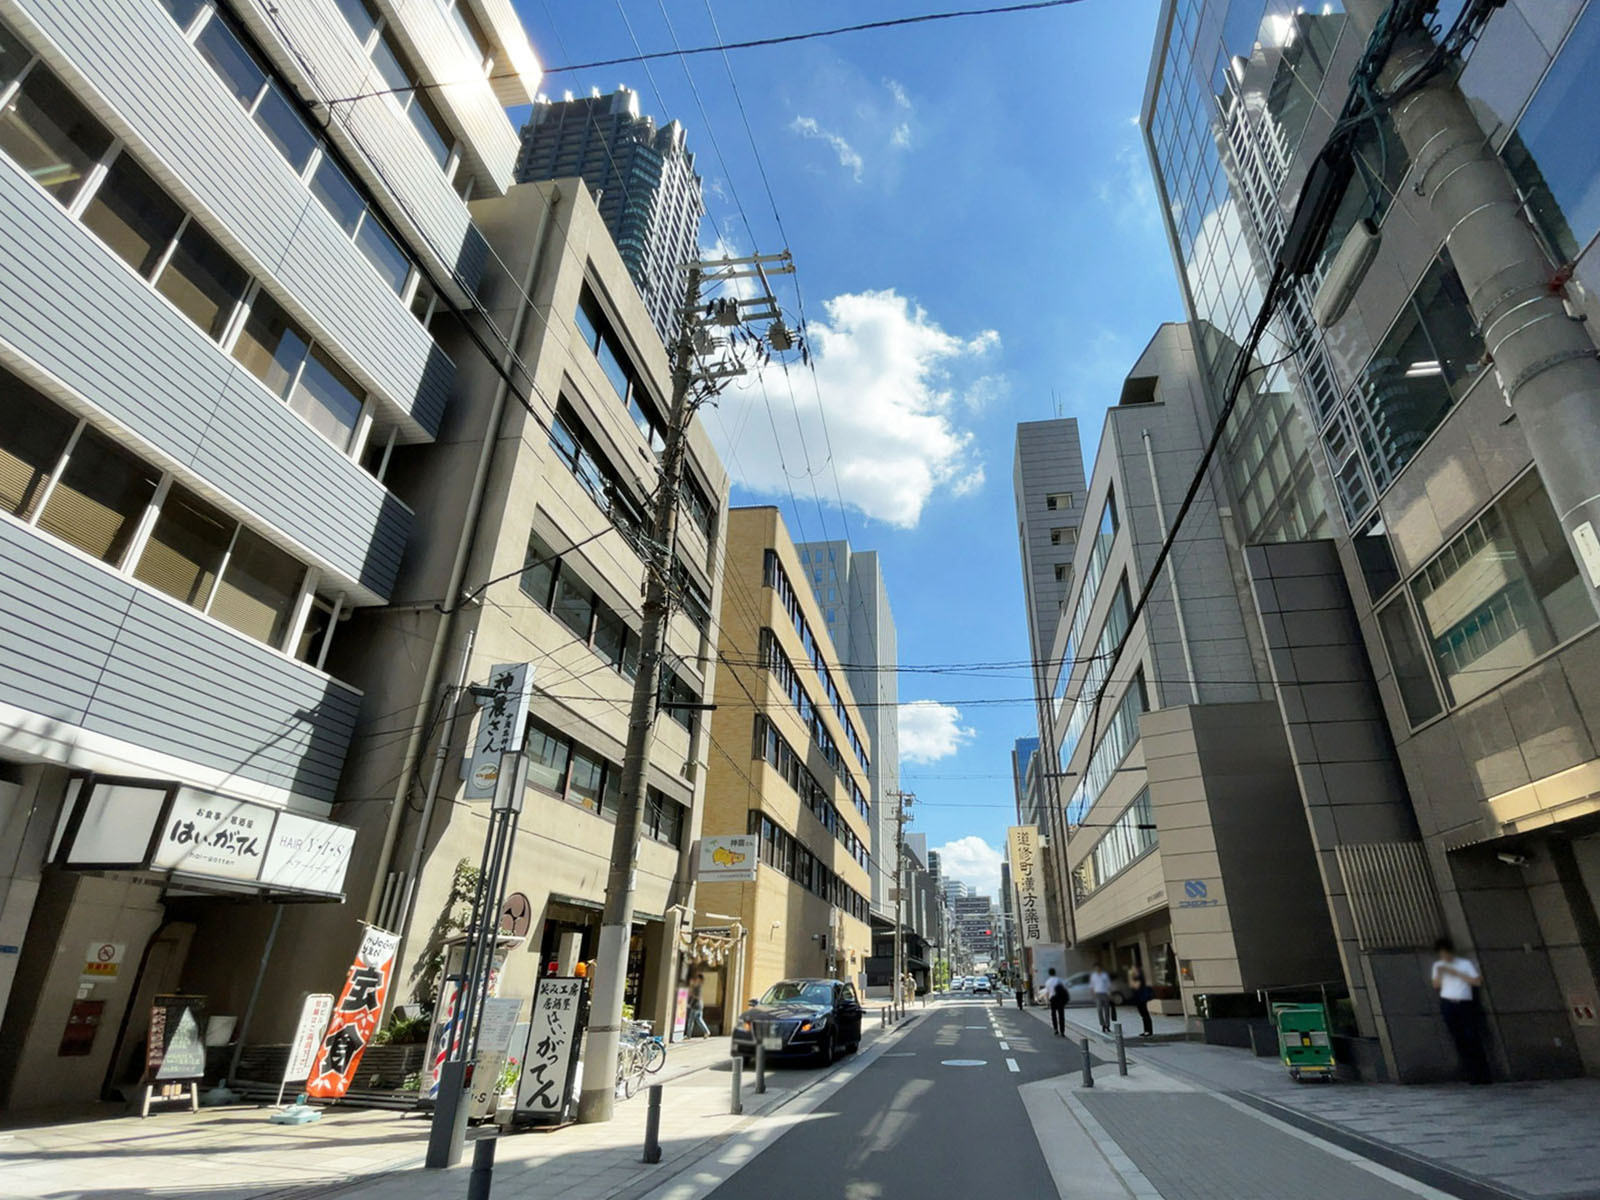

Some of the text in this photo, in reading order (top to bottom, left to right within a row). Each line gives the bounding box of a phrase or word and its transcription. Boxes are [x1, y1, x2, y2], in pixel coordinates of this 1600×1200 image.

[482, 672, 514, 753] 神農さん
[279, 835, 303, 850] HAIR
[1017, 831, 1041, 940] 道修町漢方薬局
